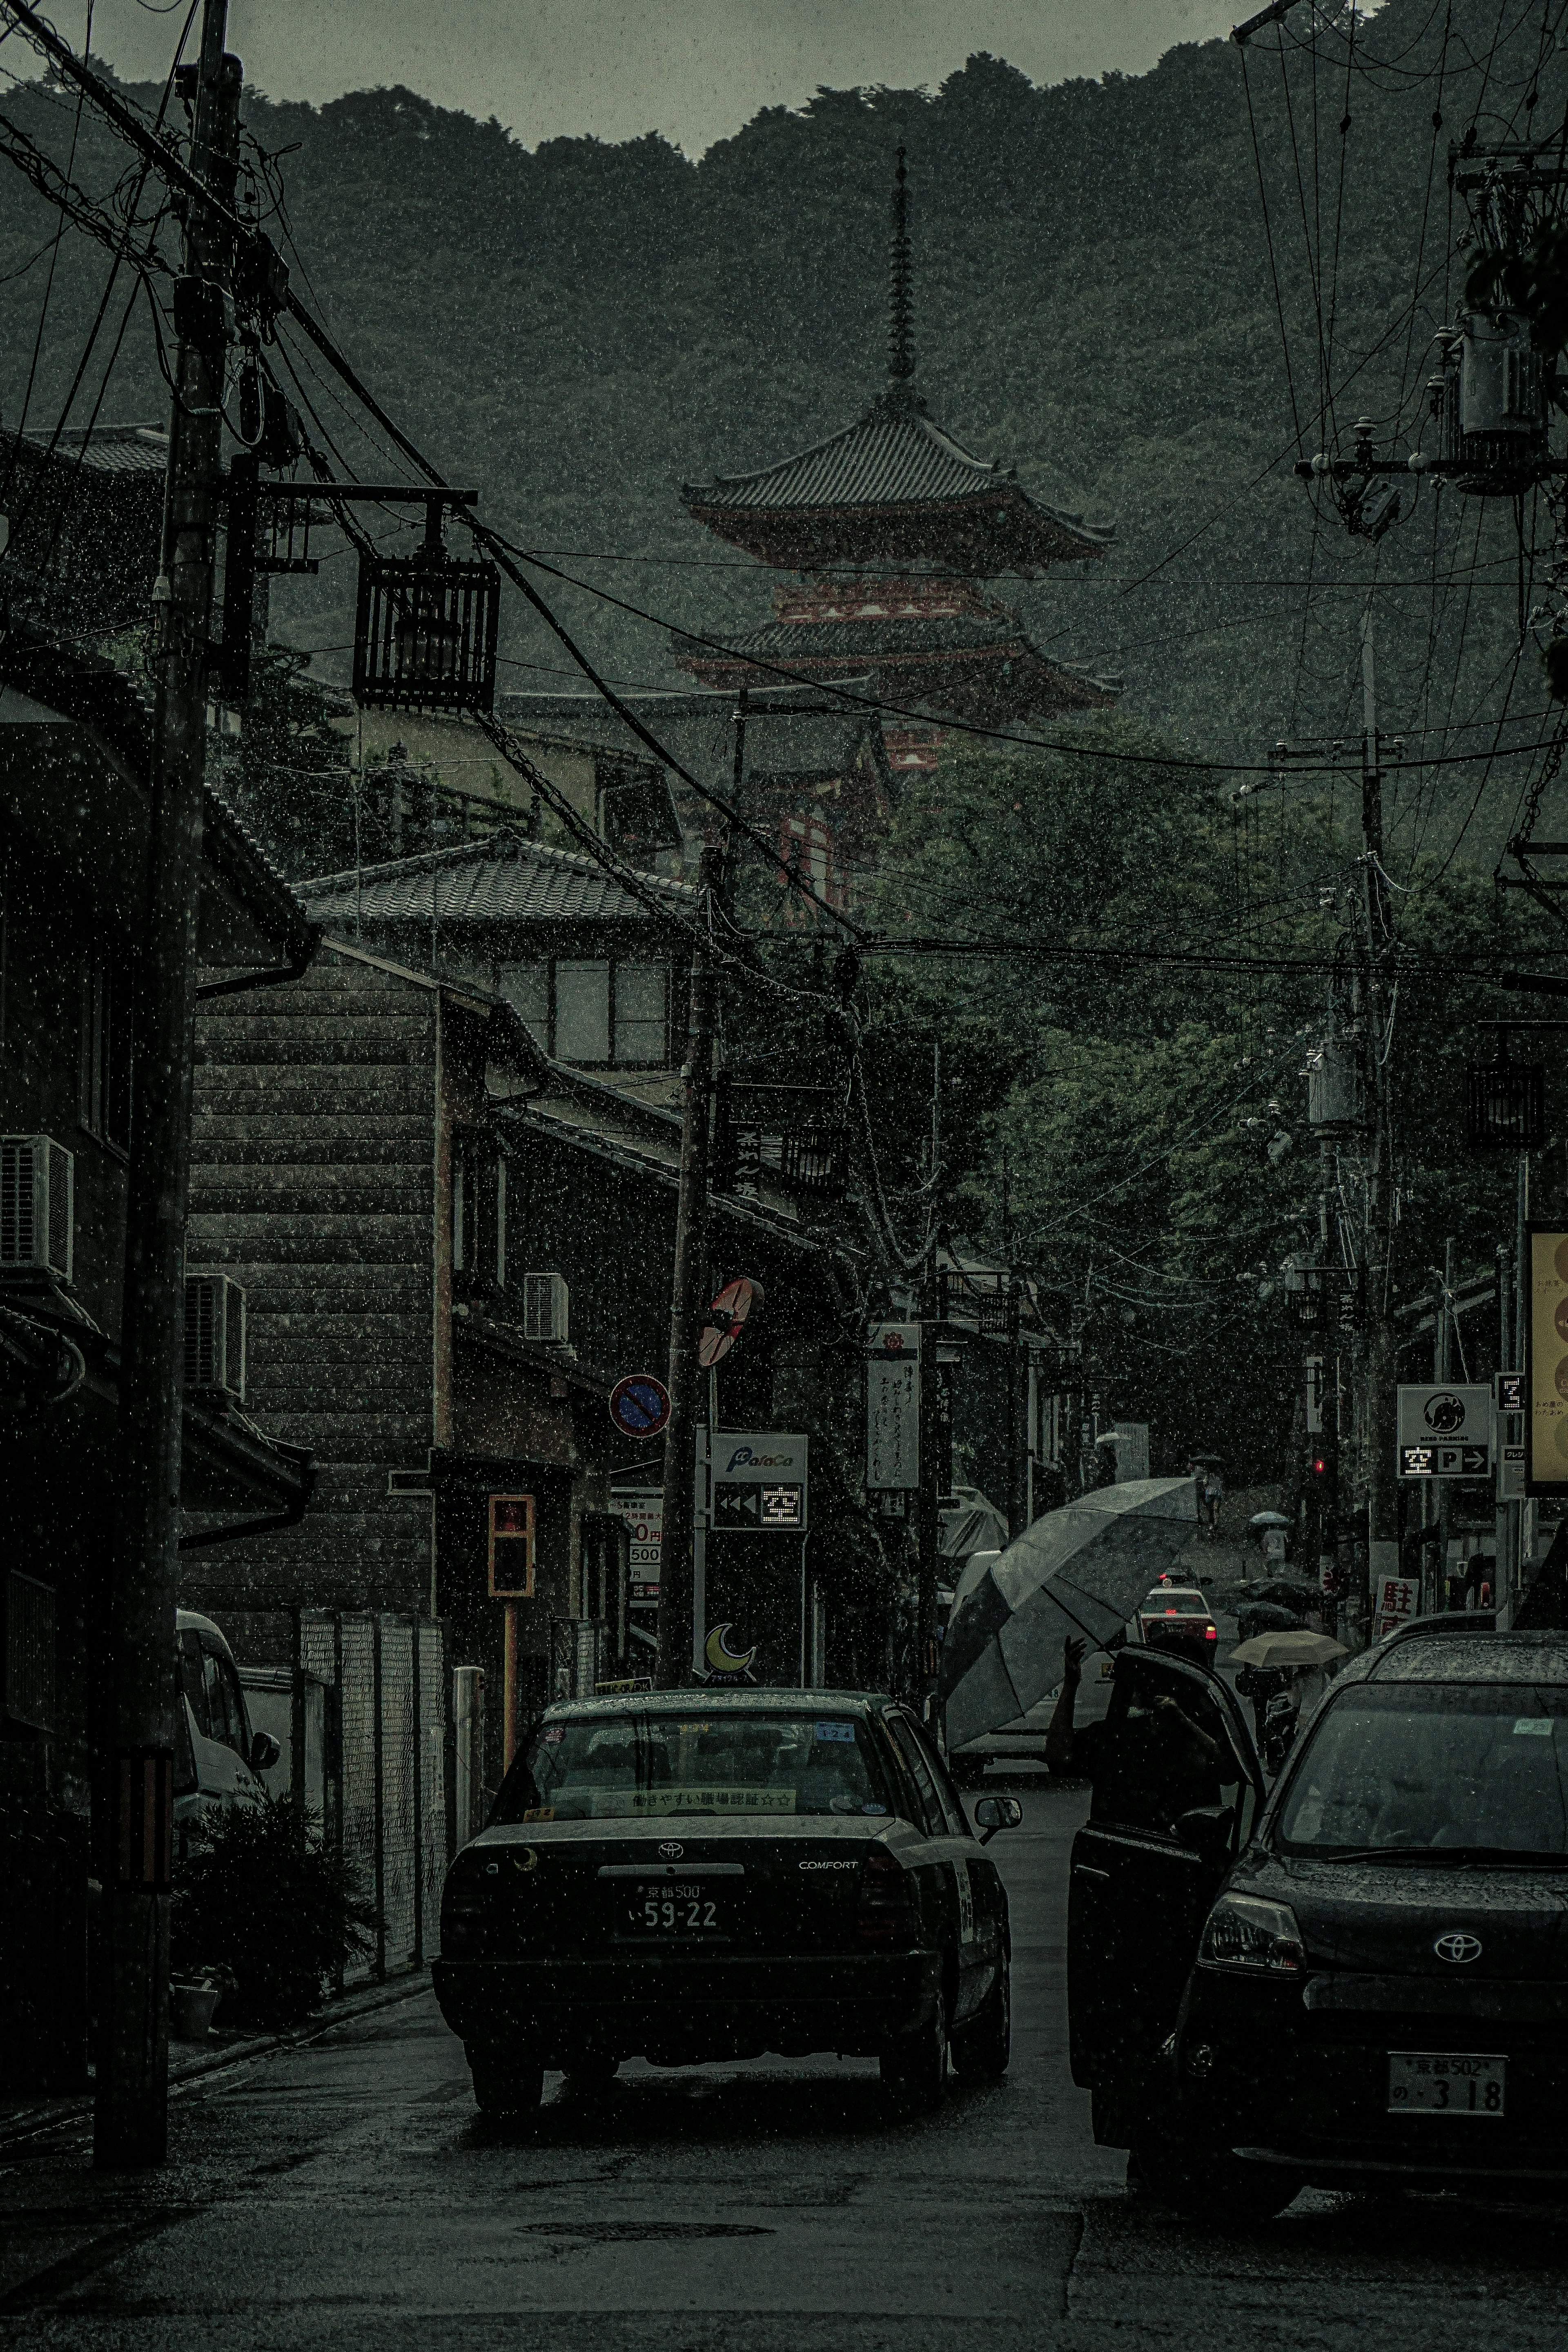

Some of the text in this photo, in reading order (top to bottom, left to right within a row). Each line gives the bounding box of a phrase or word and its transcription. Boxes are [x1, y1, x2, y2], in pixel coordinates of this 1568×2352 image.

[733, 1132, 760, 1196] 茶わん坂
[1405, 1447, 1457, 1474] 空 P
[763, 1487, 798, 1522] 空
[645, 1902, 717, 1927] 59-22
[1394, 2086, 1408, 2100] の
